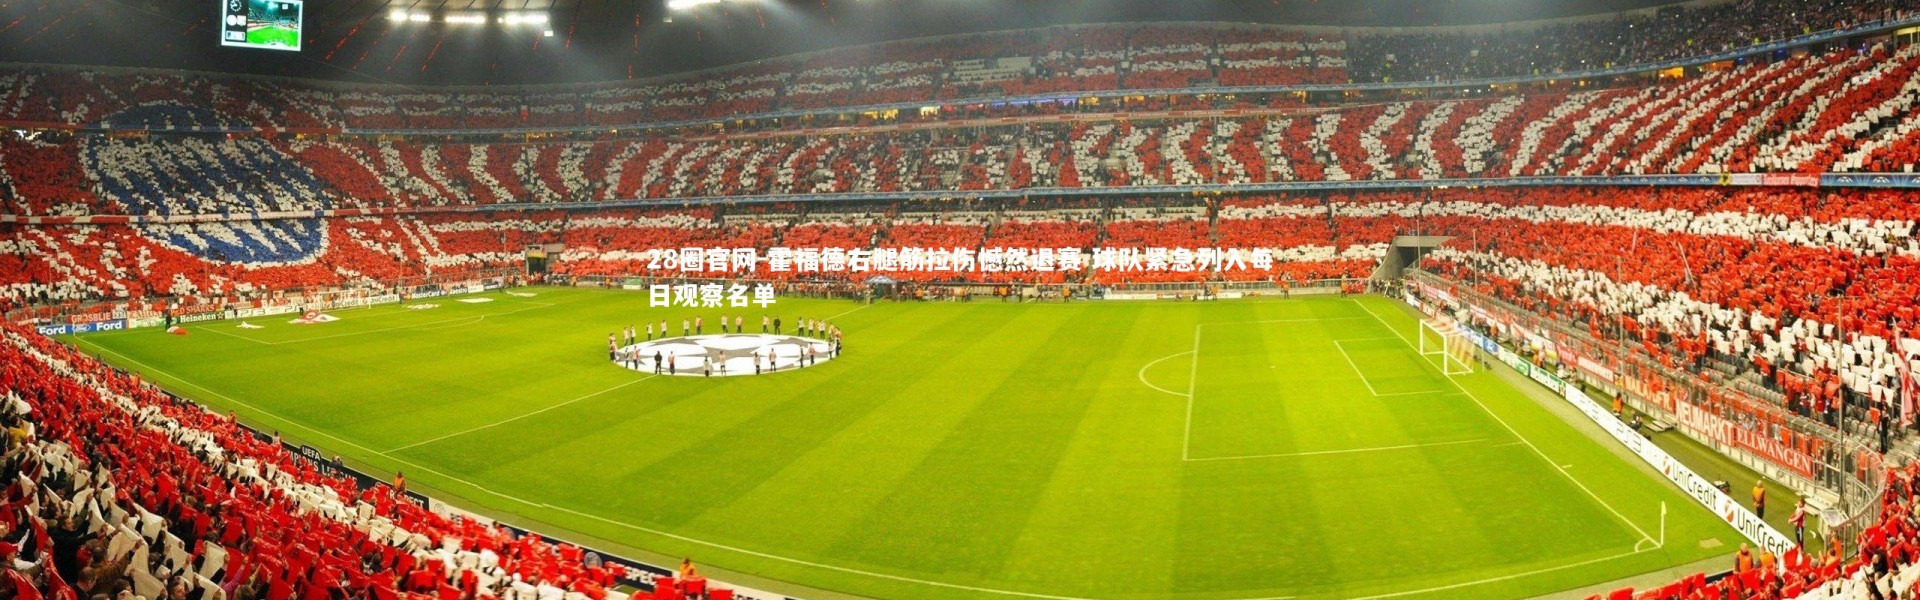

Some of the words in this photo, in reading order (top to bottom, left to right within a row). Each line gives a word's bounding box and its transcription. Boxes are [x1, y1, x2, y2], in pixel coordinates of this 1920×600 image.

[38, 325, 66, 336] Ford
[96, 320, 123, 331] Ford
[180, 313, 217, 324] Heineken
[1677, 400, 1734, 447] NEUMARKT
[301, 446, 321, 461] UEFA
[1737, 426, 1811, 474] ELLWANGEN
[1672, 462, 1717, 510] UniCredit
[1737, 508, 1796, 561] UniCredi
